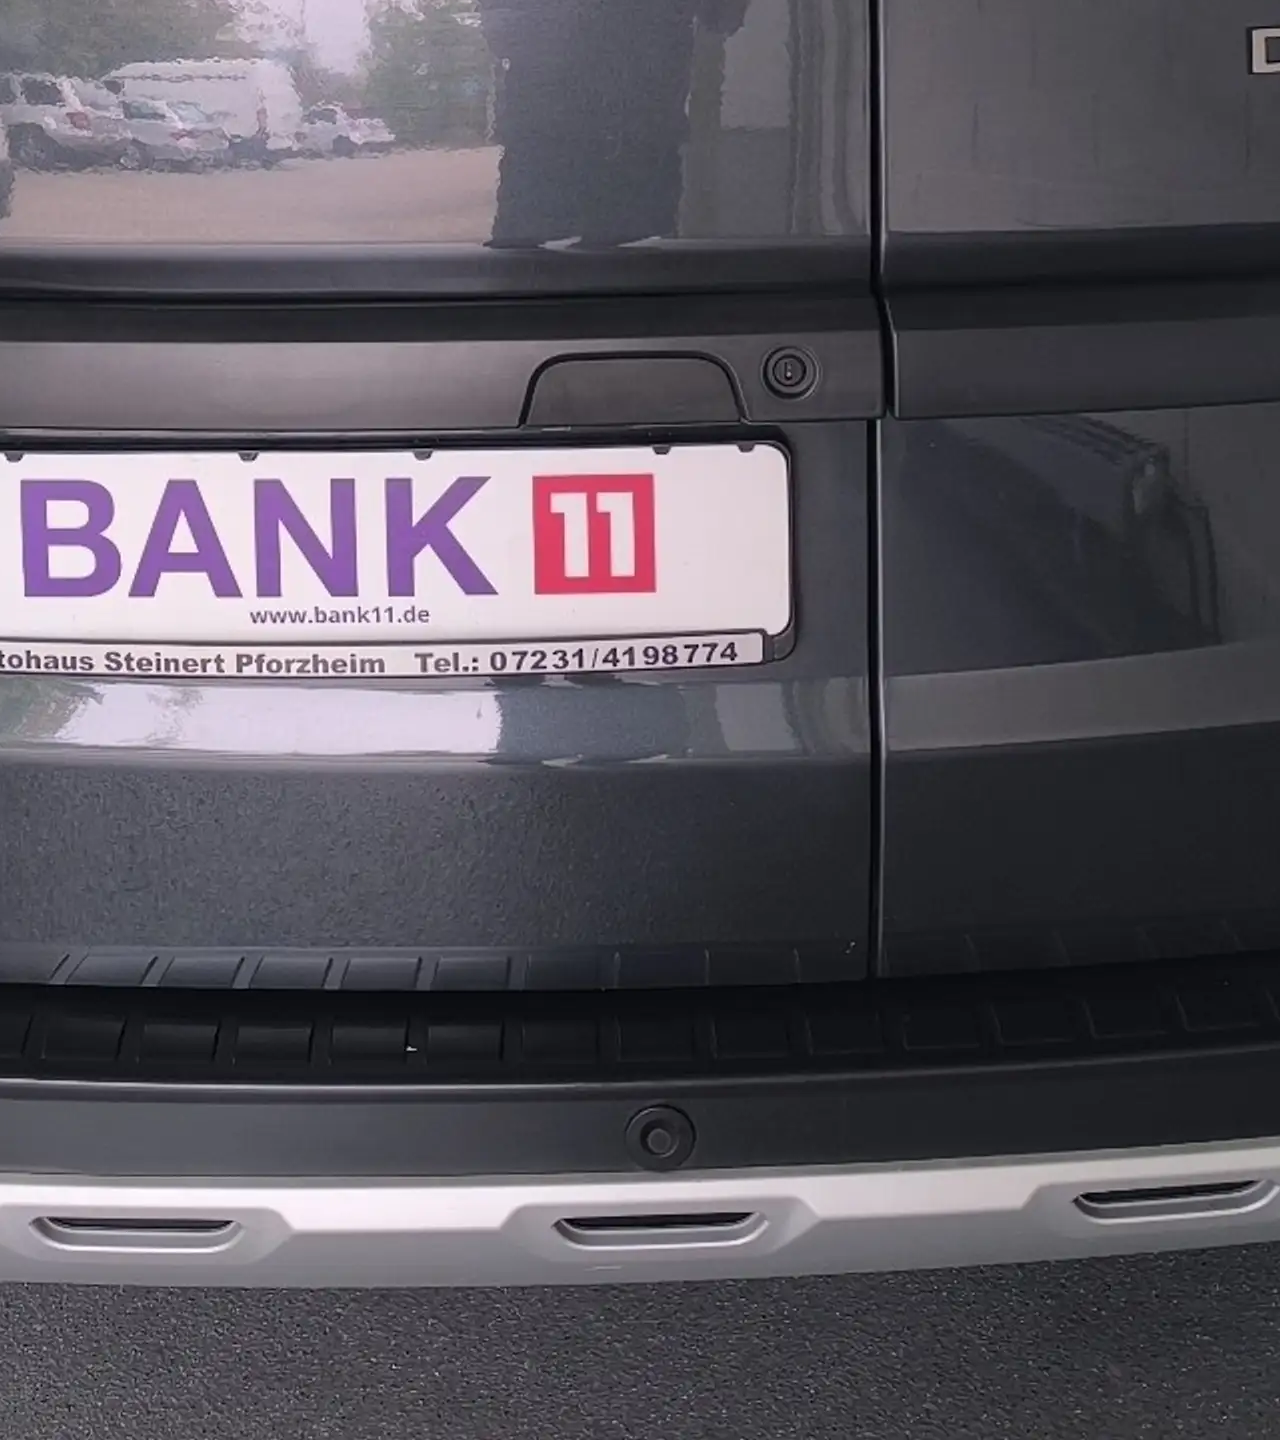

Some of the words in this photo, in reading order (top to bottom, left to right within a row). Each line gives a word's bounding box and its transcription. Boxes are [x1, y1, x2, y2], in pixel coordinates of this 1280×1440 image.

[20, 476, 499, 598] BANK
[549, 491, 636, 578] 11
[250, 606, 431, 625] www.bank11.de
[104, 651, 226, 674] Steinert
[236, 652, 386, 674] Pforzheim
[414, 651, 480, 674] Tel.:
[489, 641, 738, 672] 07231/4198774
